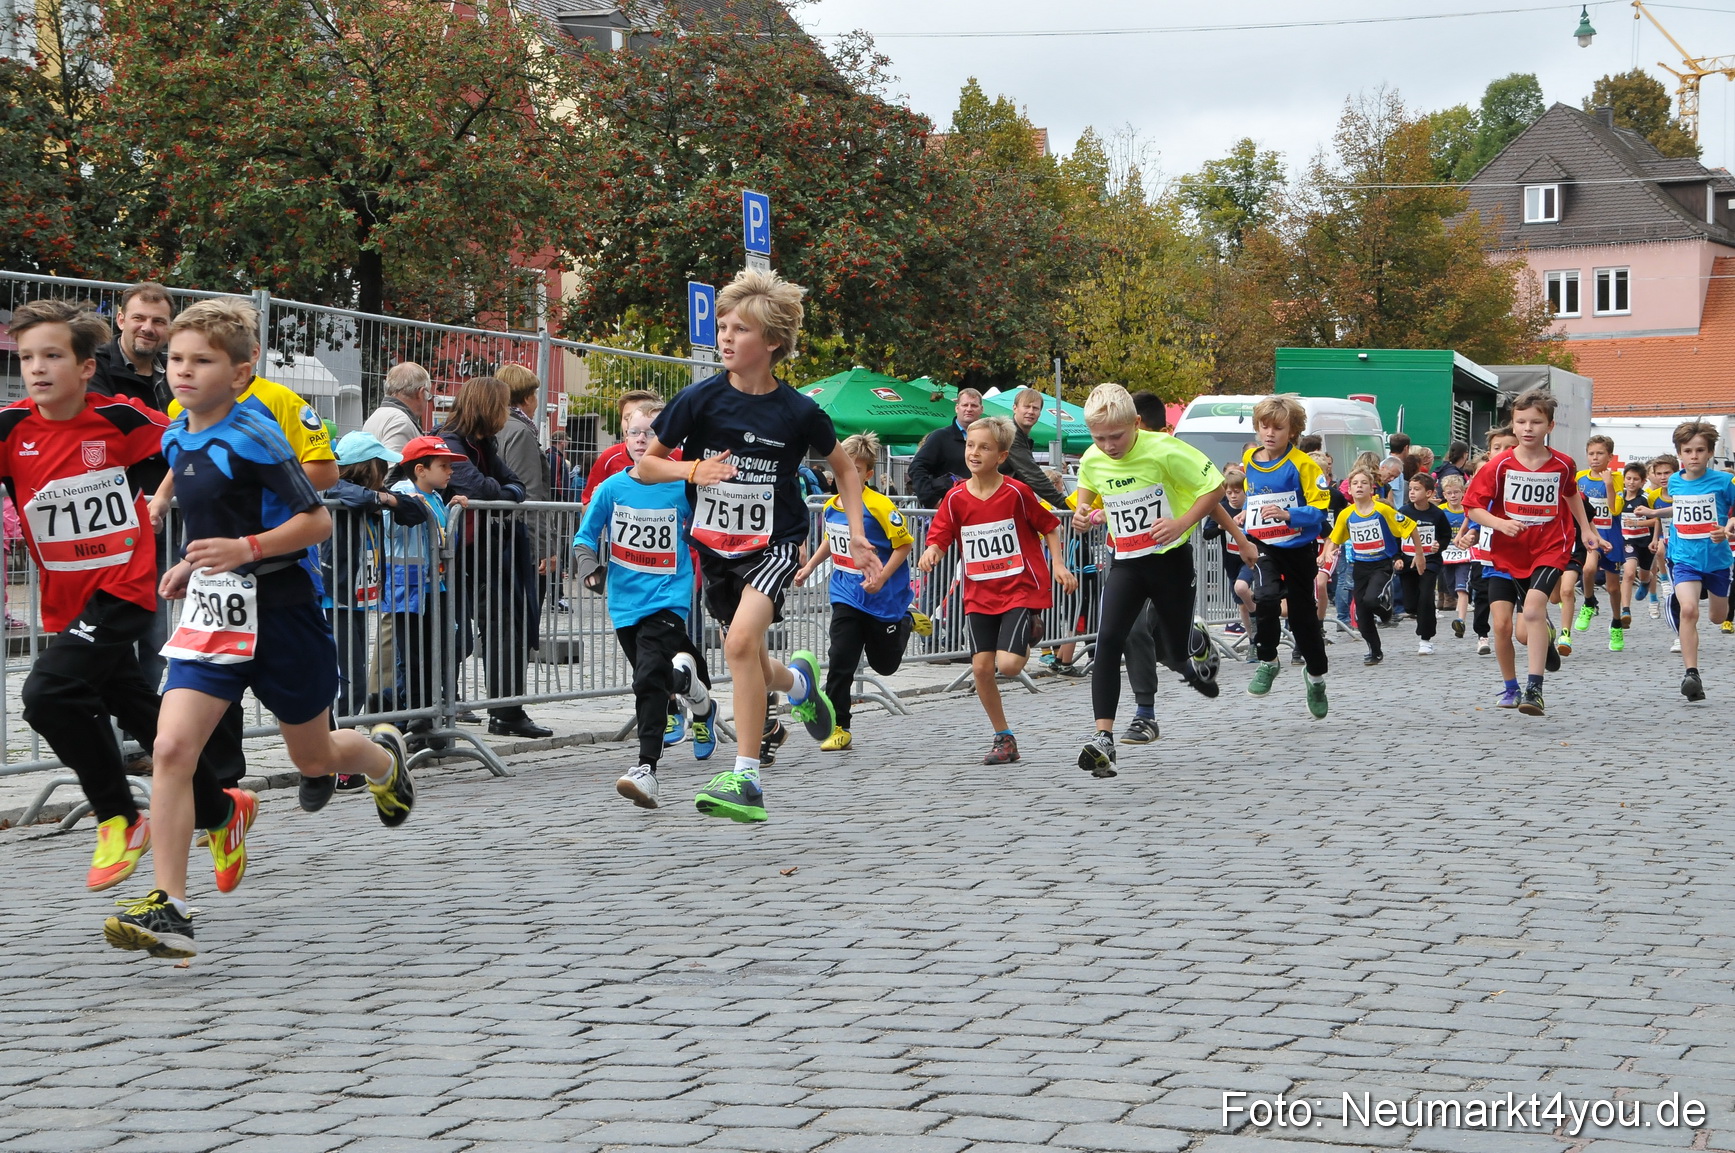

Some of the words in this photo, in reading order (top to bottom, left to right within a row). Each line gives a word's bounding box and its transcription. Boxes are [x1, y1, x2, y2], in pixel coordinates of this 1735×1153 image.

[748, 199, 764, 244] P
[694, 291, 710, 337] P
[703, 447, 779, 473] GRNDSCHULE
[62, 479, 112, 498] Neumarkt
[698, 485, 721, 496] PARTL
[1106, 477, 1137, 490] Team
[1121, 493, 1154, 507] Neumarkt
[1510, 482, 1555, 503] 7098
[36, 491, 128, 537] 7120
[704, 497, 766, 532] 7519
[1110, 499, 1163, 534] 7527
[1517, 505, 1544, 515] Philipp
[1676, 505, 1713, 522] 7565
[633, 515, 667, 523] Neumarkt
[615, 519, 672, 550] 7238
[978, 526, 1006, 536] Neumarkt
[1257, 527, 1291, 539] Jonathan
[1351, 527, 1380, 542] 7528
[74, 542, 107, 558] Nico
[965, 533, 1015, 560] 7040
[1445, 549, 1468, 560] 7231
[625, 550, 657, 567] Philipp
[982, 562, 1005, 572] Lukas
